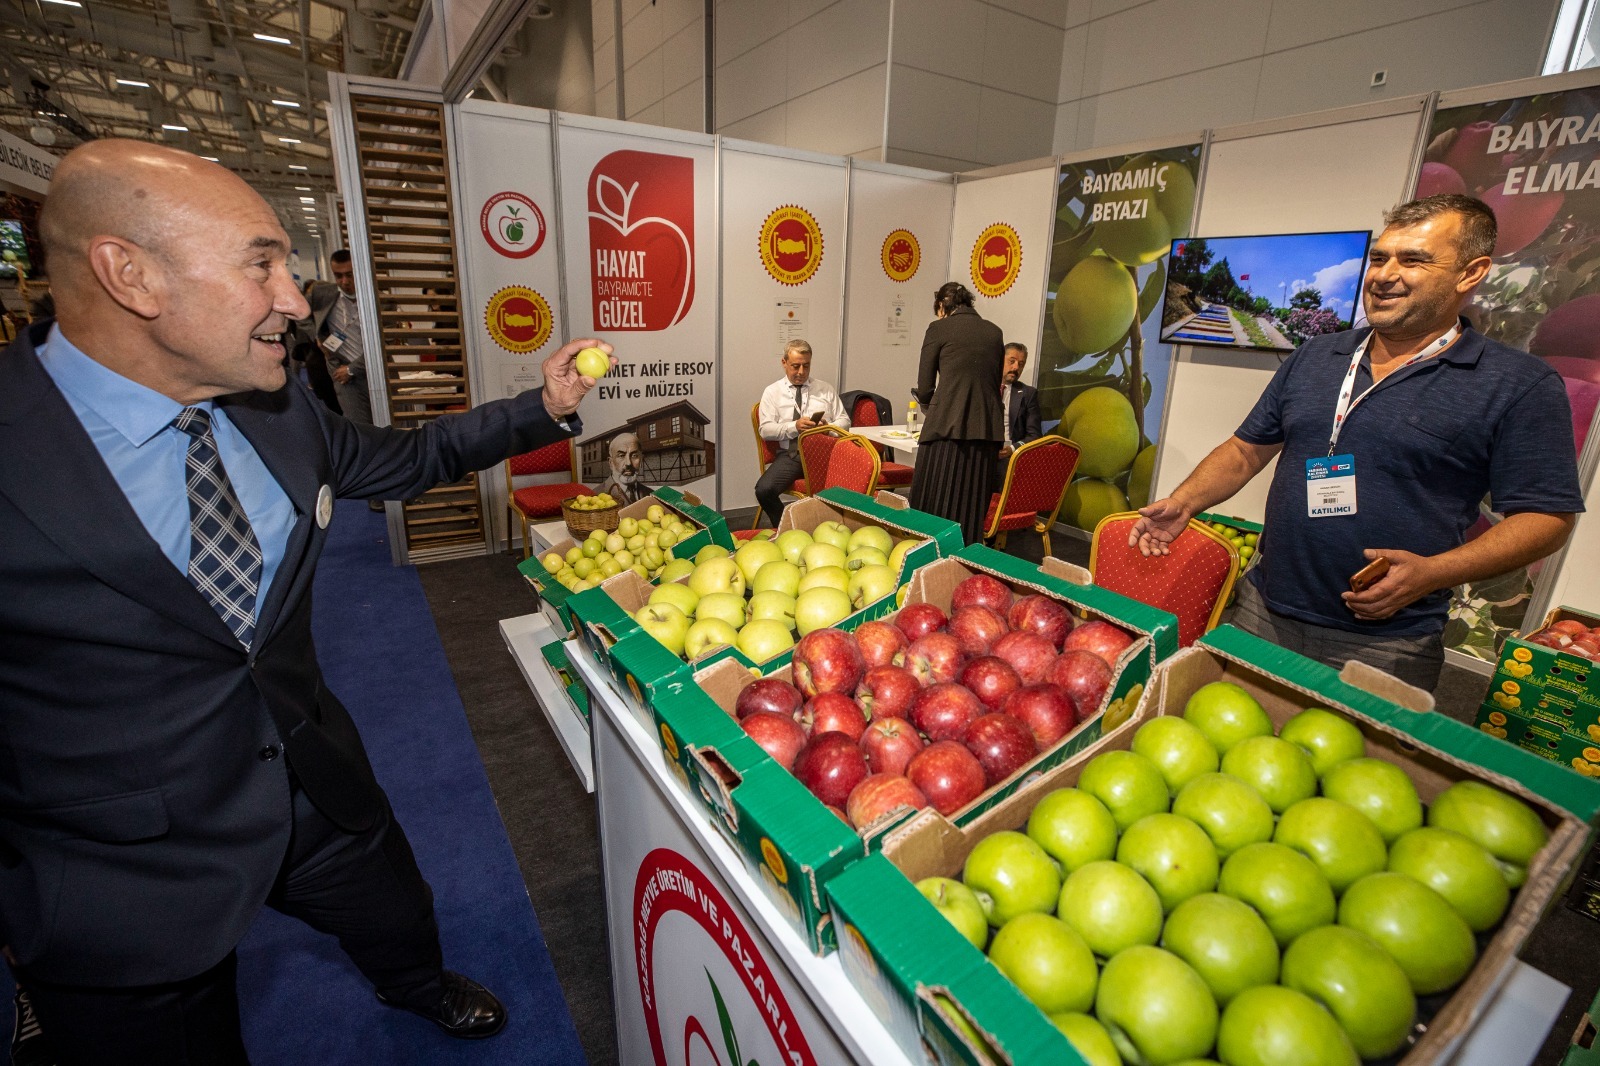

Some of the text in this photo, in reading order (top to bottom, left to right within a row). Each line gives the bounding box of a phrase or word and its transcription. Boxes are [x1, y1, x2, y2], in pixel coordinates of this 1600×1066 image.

[1486, 112, 1600, 154] BAYRA
[1082, 162, 1168, 194] BAYRAMİÇ
[1502, 160, 1600, 196] ELMA
[1092, 198, 1148, 222] BEYAZI
[596, 248, 646, 278] HAYAT
[598, 280, 652, 296] BAYRAMİÇ'TE
[600, 296, 646, 328] GÜZEL
[640, 360, 670, 376] AKİF
[674, 362, 714, 376] ERSOY
[599, 380, 694, 400] EVİ ve MÜZESİ
[1312, 506, 1350, 514] KATILIMCI
[640, 875, 660, 928] MEYVE
[656, 866, 697, 903] ÜRETİM
[698, 887, 719, 928] VE
